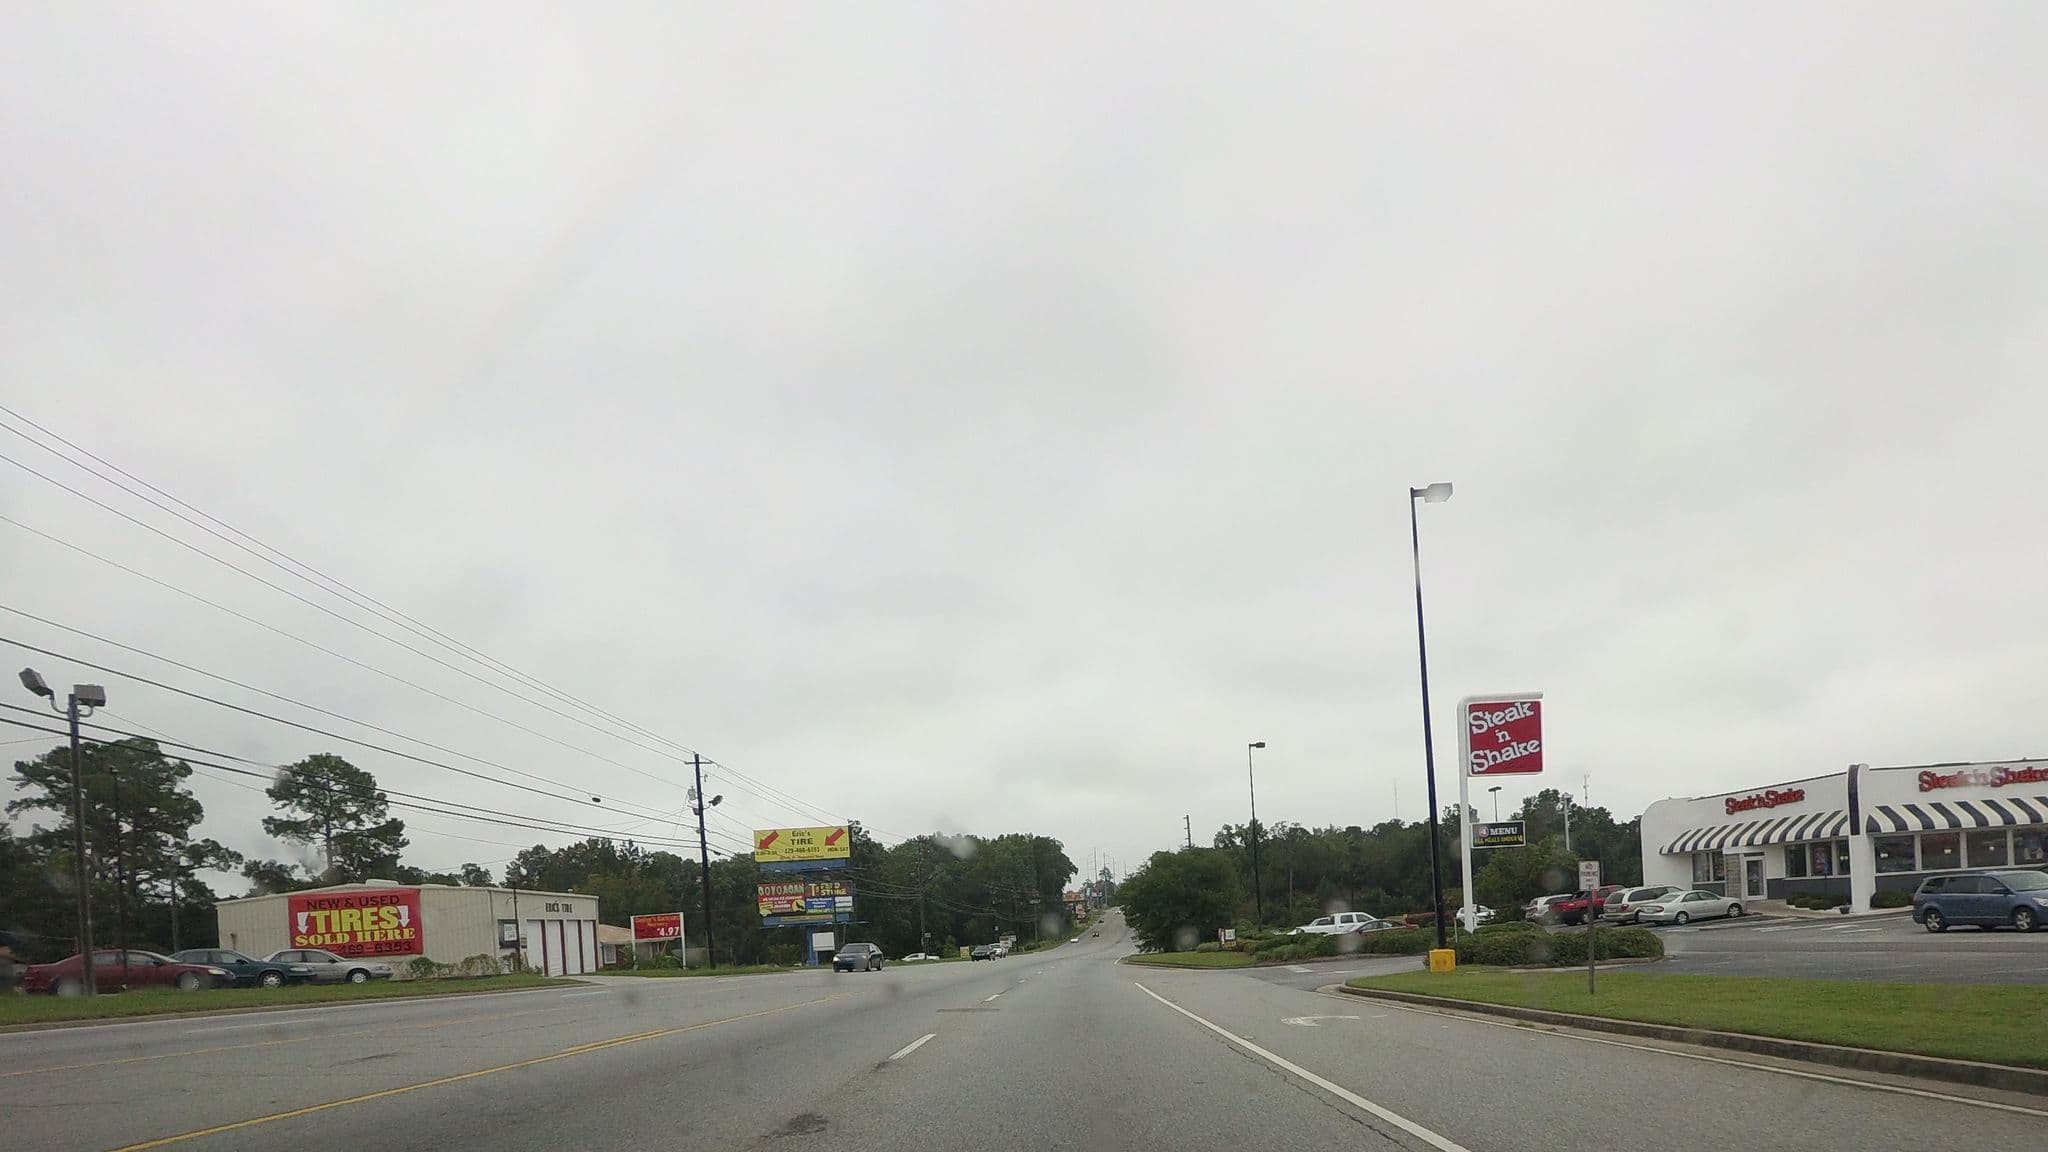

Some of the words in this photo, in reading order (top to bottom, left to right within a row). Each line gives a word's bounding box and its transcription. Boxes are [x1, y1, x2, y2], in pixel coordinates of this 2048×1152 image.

[1470, 701, 1534, 735] Steak
[1471, 739, 1540, 773] Shake
[792, 830, 810, 838] Eric's
[1490, 827, 1517, 835] MENU
[790, 838, 814, 846] TIRE
[307, 899, 340, 910] NEW
[344, 898, 356, 907] &
[360, 895, 399, 906] USED
[309, 906, 399, 934] TIRES
[295, 933, 350, 947] SOLD
[356, 928, 416, 943] HERE
